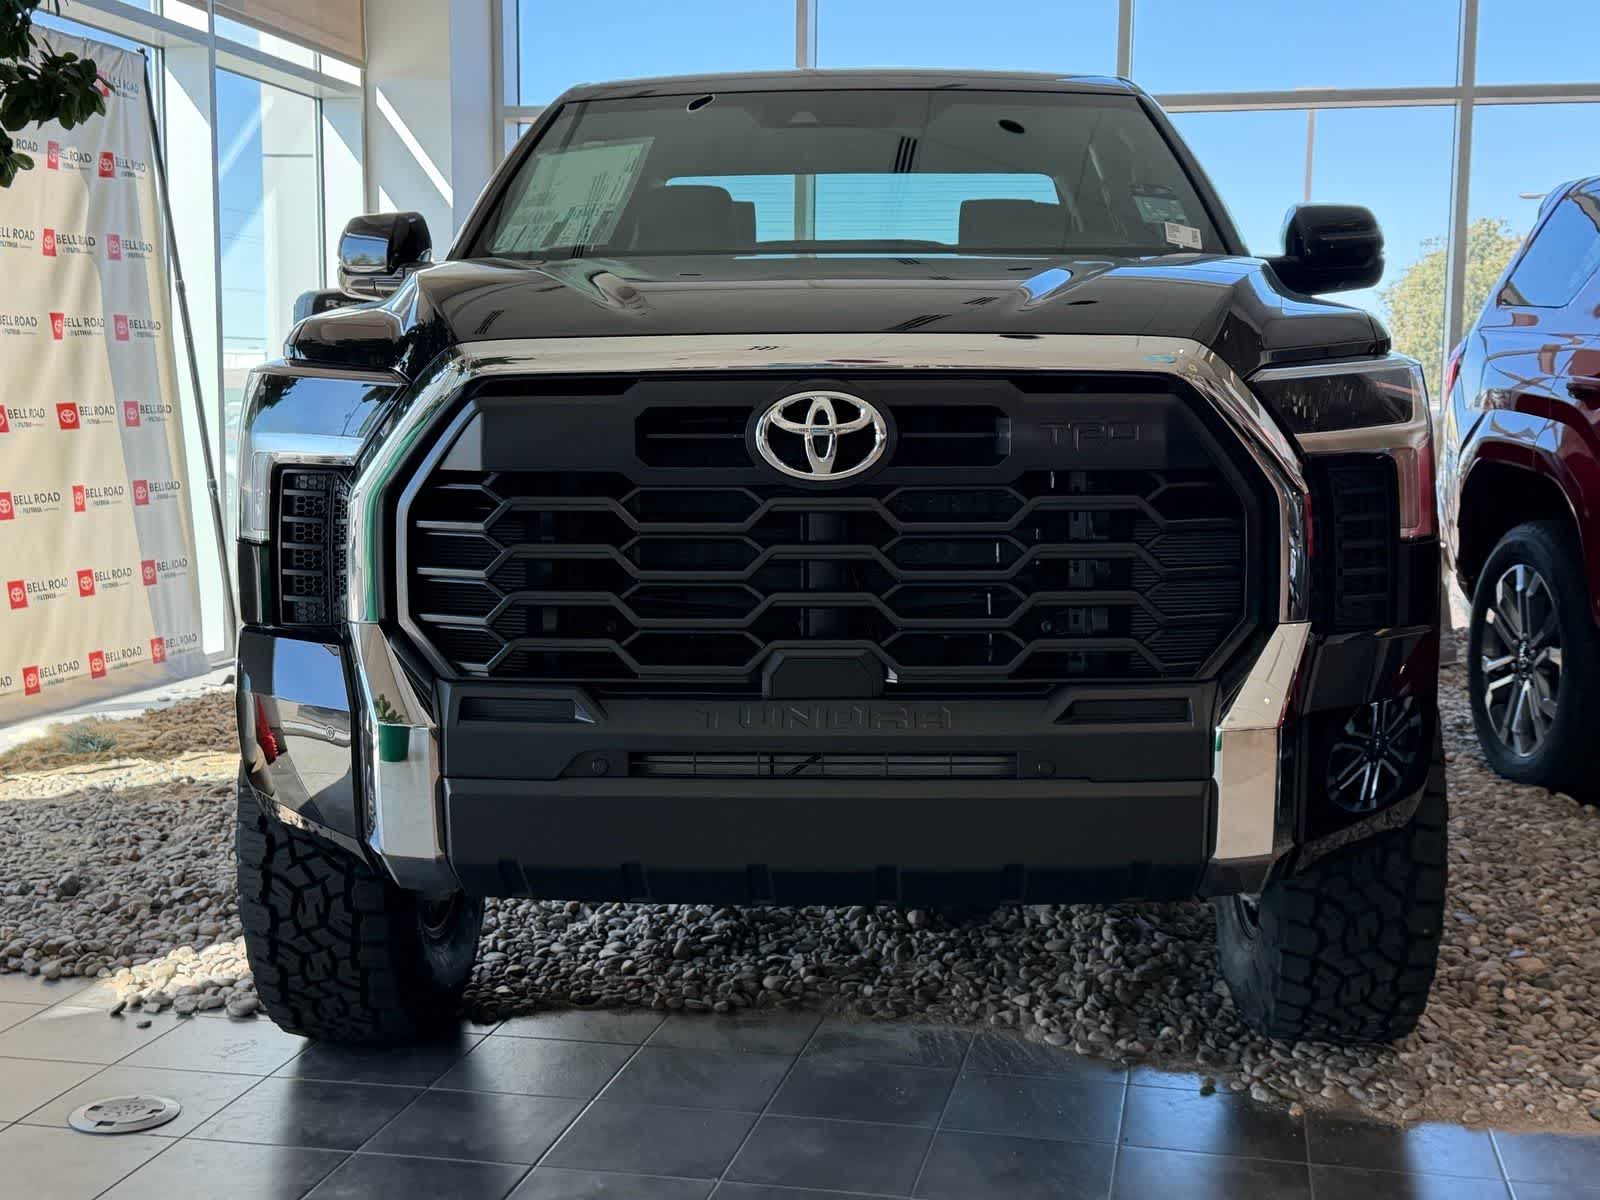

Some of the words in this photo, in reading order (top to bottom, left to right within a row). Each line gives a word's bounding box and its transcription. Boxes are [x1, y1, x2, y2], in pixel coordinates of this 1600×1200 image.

[16, 139, 39, 152] ROAD
[69, 151, 92, 163] ROAD
[0, 228, 12, 239] ELL
[12, 230, 35, 241] ROAD
[56, 234, 78, 246] BELL
[15, 316, 38, 327] ROAD
[64, 316, 82, 328] BELL
[83, 317, 104, 328] ROAD
[129, 319, 146, 331] BELL
[8, 408, 28, 420] BELL
[79, 406, 94, 417] BELL
[94, 405, 115, 416] ROAD
[140, 403, 156, 415] BELL
[85, 486, 103, 499] BELL
[103, 485, 124, 497] ROAD
[149, 481, 164, 492] BELL
[14, 494, 34, 506] BELL
[35, 491, 61, 504] ROAD
[95, 571, 112, 582] BELL
[112, 567, 133, 579] ROAD
[27, 581, 48, 593] BELL
[48, 577, 69, 589] ROAD
[180, 632, 197, 646] ROAD
[105, 651, 123, 664] BELL
[123, 645, 142, 660] ROAD
[39, 663, 57, 678] BELL
[58, 659, 80, 674] ROAD
[0, 675, 12, 688] AD
[695, 704, 954, 730] TUNDRA
